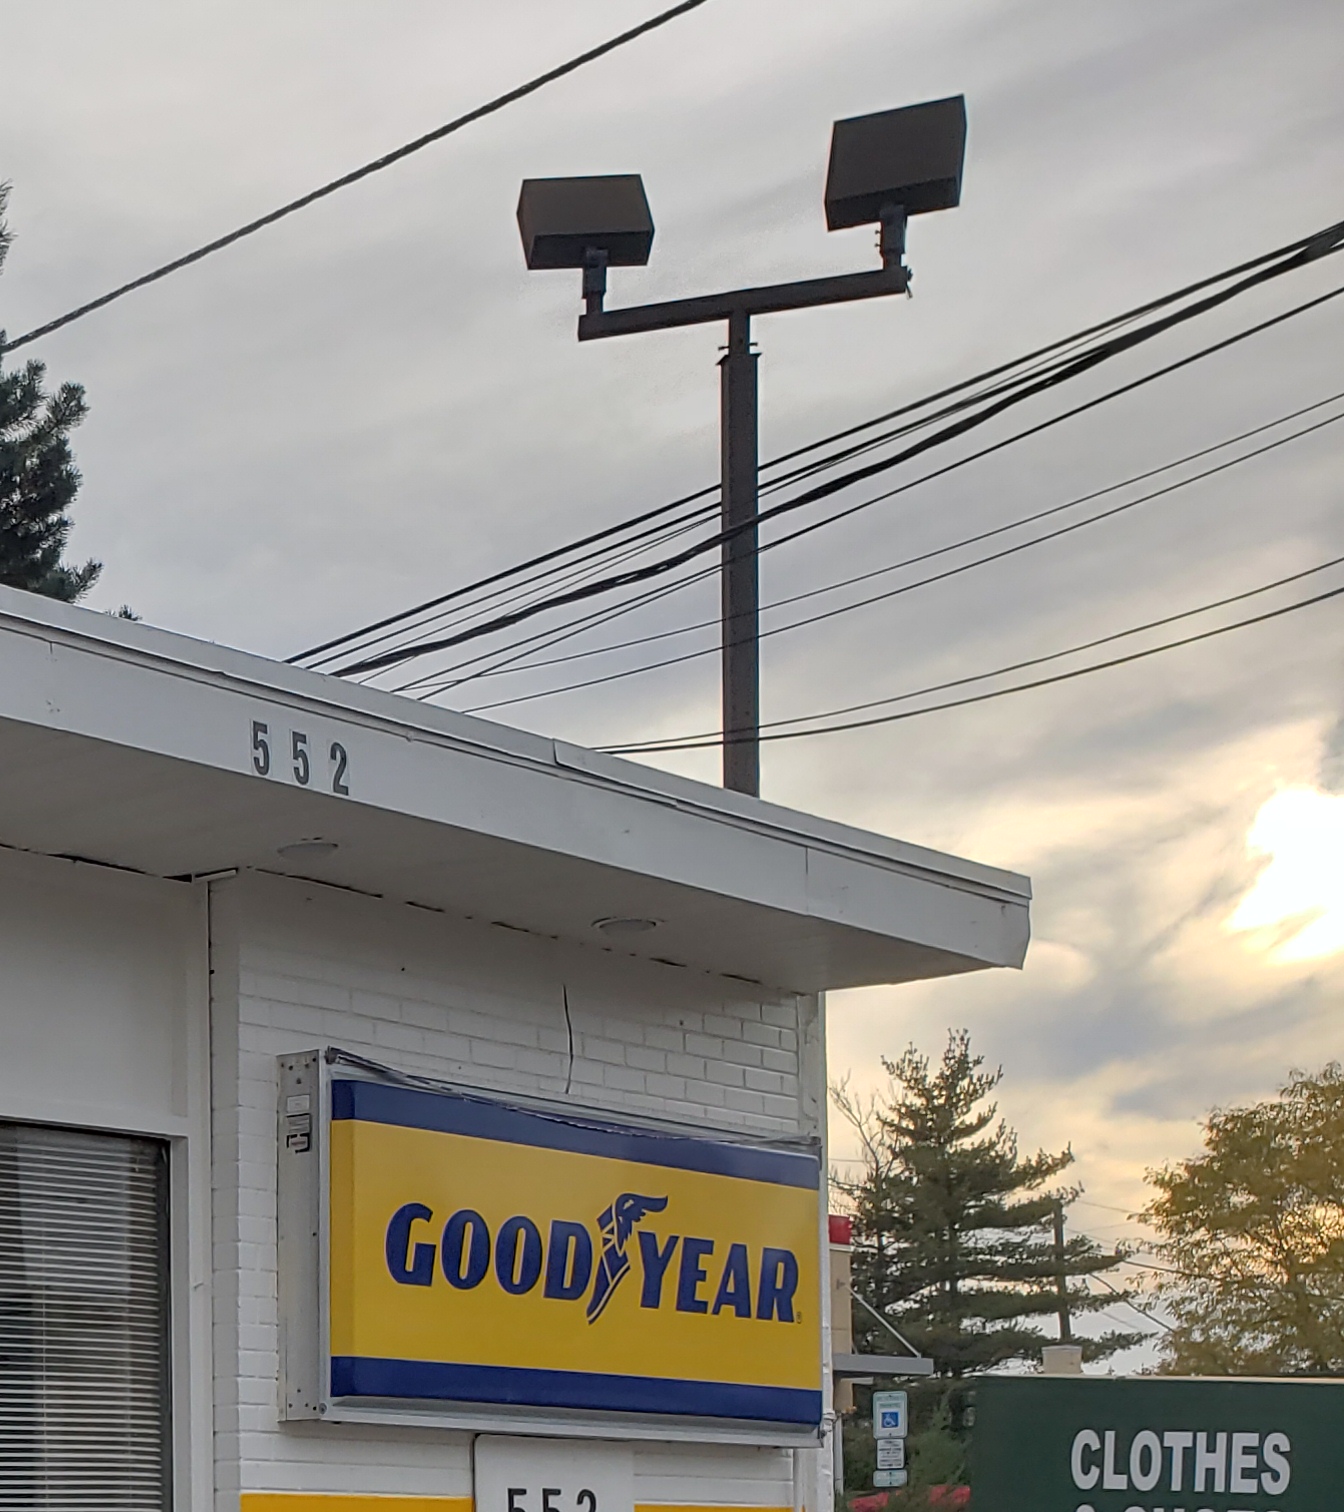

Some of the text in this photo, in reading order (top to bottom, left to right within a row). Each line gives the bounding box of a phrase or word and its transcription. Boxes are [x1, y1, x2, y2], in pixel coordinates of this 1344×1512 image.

[252, 720, 349, 796] 552
[384, 1195, 800, 1324] GOODYEAR
[1070, 1429, 1292, 1495] CLOTHES
